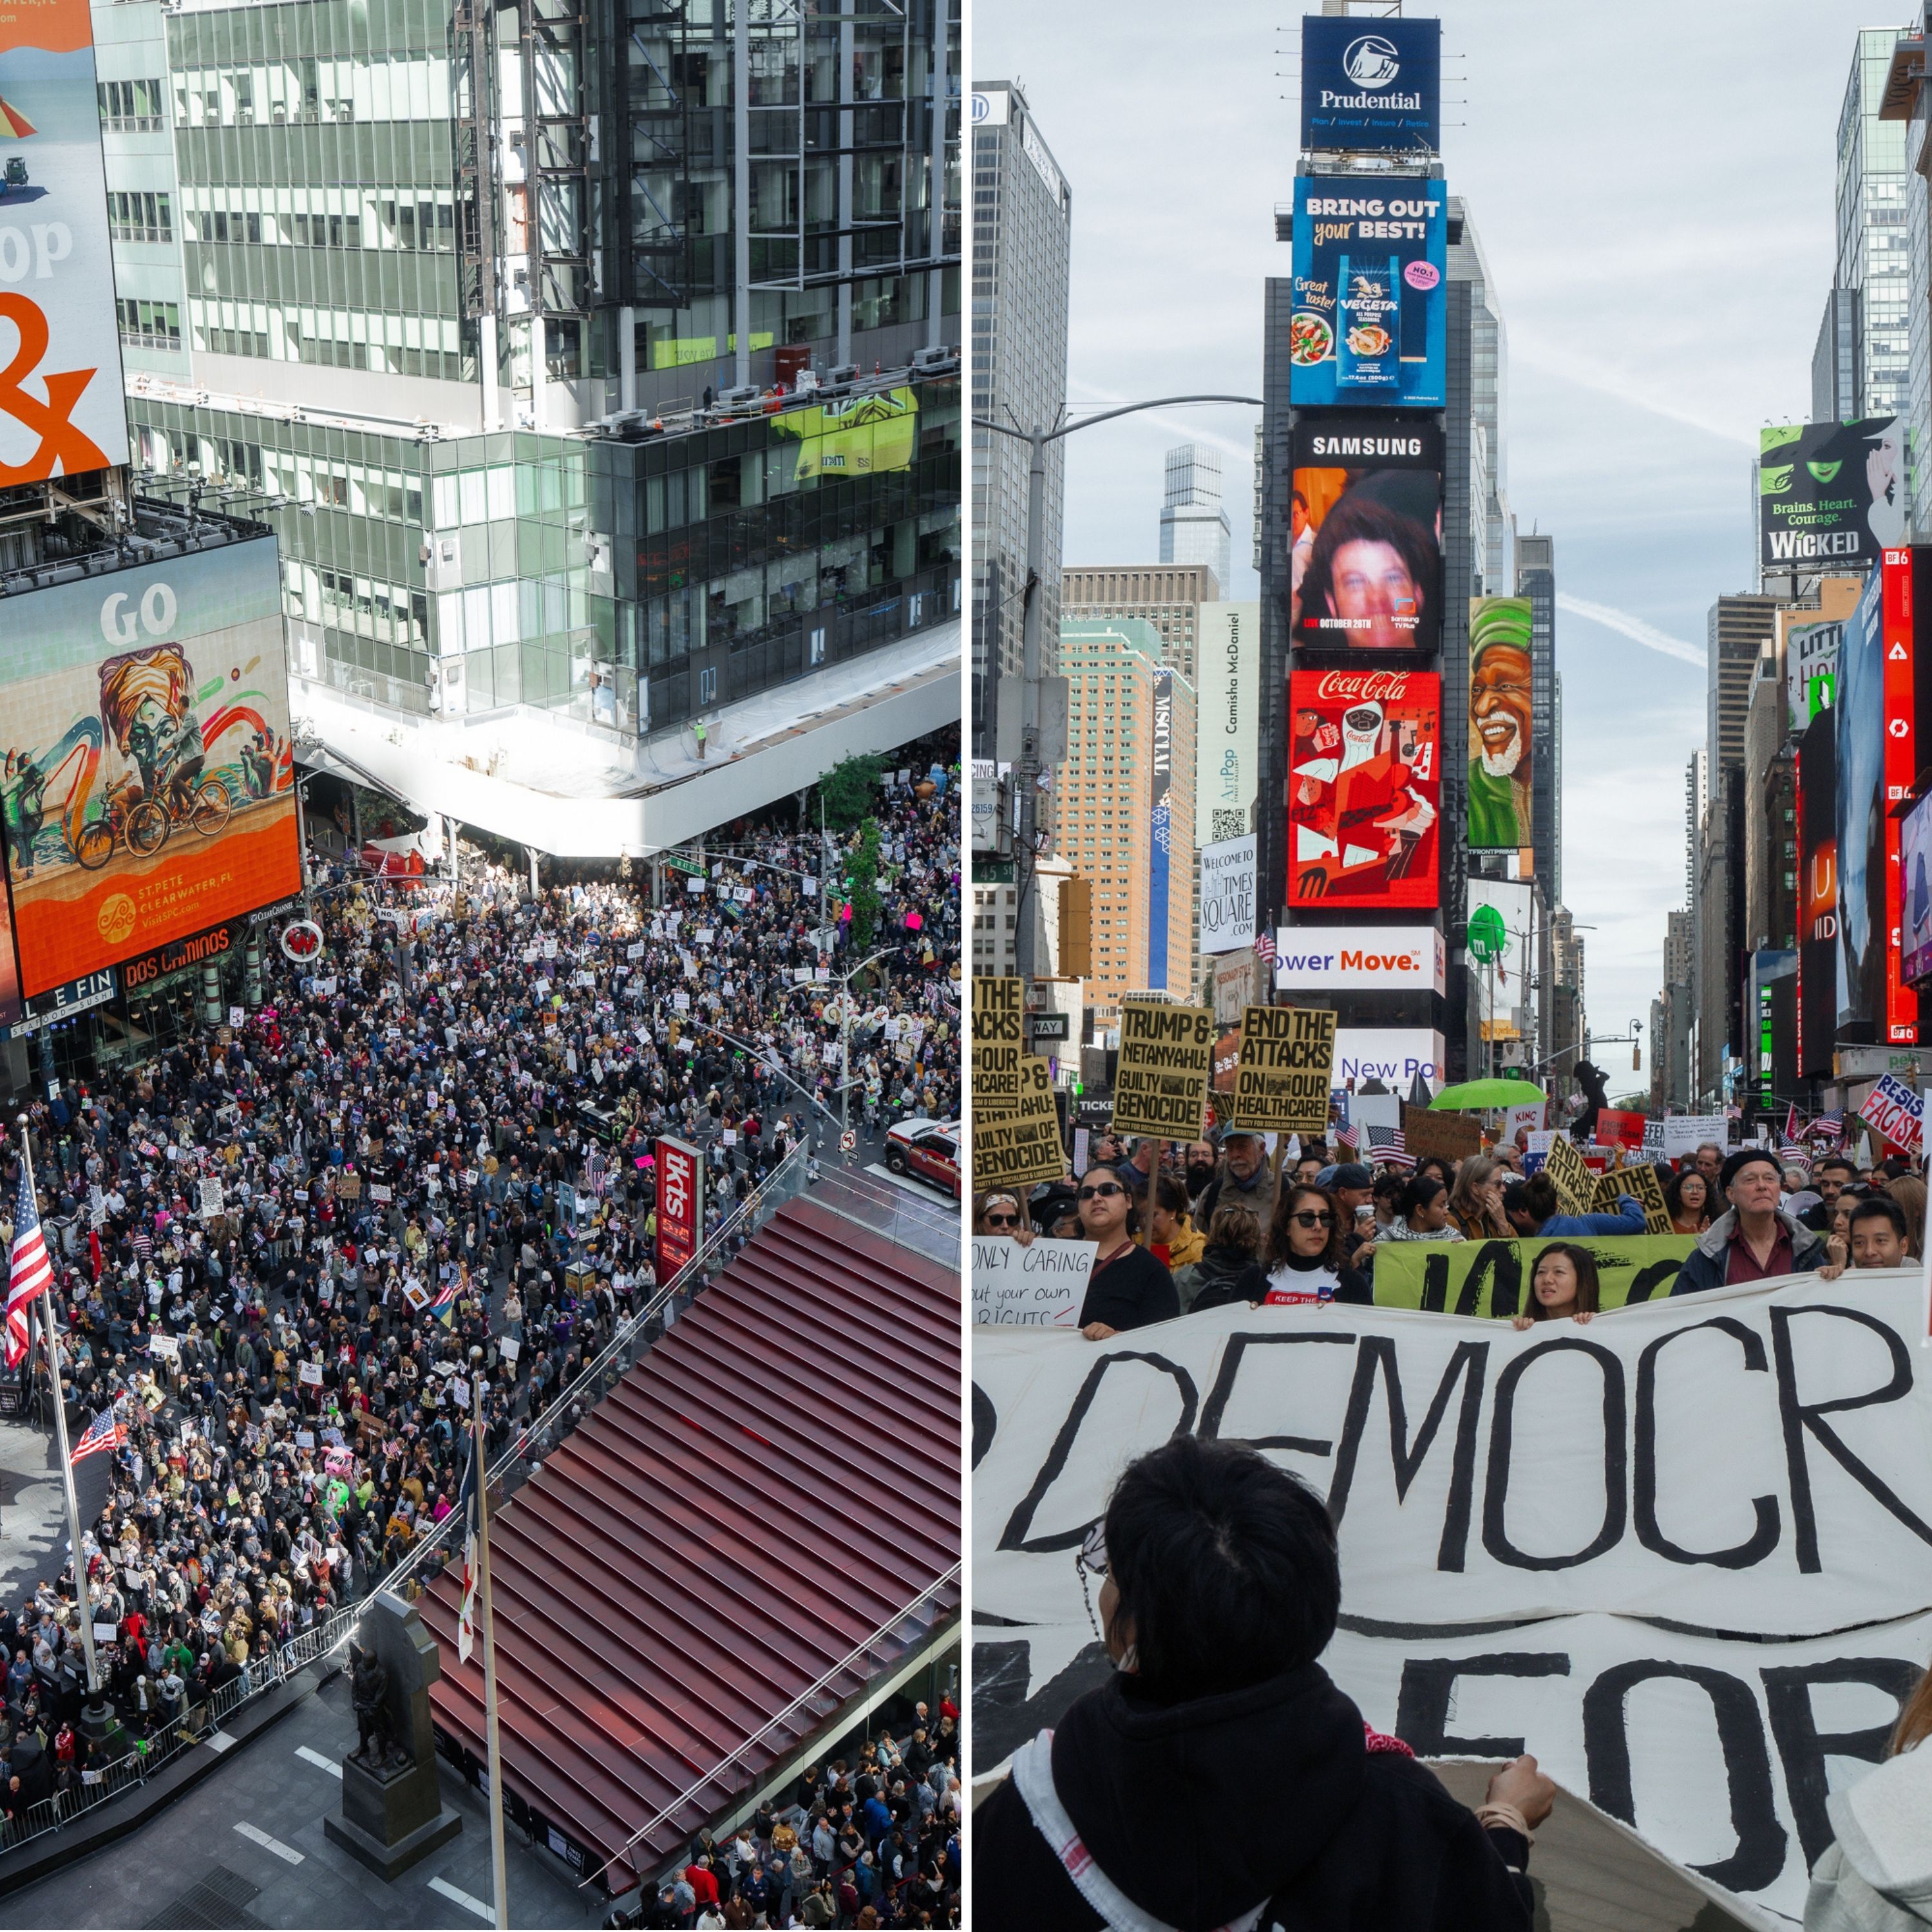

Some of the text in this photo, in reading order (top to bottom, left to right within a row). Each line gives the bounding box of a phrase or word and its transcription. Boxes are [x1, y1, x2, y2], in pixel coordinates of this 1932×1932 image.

[1320, 90, 1421, 110] Prudential
[1312, 117, 1329, 126] Plan
[1338, 118, 1362, 126] Invest
[1406, 120, 1430, 128] Retire
[1306, 198, 1441, 218] BRING OUT
[1314, 220, 1426, 247] your BEST!
[1412, 265, 1434, 278] NO.1
[1294, 276, 1329, 294] Great
[1305, 291, 1337, 310] taste!
[1340, 299, 1398, 311] VEGETA
[1312, 437, 1422, 456] SAMSUNG
[1772, 498, 1857, 515] Brains. Heart.
[1788, 513, 1842, 526] Courage.
[1900, 551, 1908, 565] 6
[100, 582, 177, 647] GO
[1303, 618, 1319, 628] LIVE
[1320, 618, 1352, 629] OCTOBER
[1390, 616, 1419, 625] Samsung
[1226, 612, 1239, 674] McDaniel
[1318, 670, 1412, 701] Coca-Cola
[1226, 677, 1238, 735] Camisha
[1220, 749, 1237, 802] ArtPop
[1203, 849, 1253, 871] WELCOME TO
[980, 865, 1014, 882] 45 St
[1224, 871, 1253, 896] TIMES
[138, 874, 184, 900] ST.PETE
[141, 901, 200, 929] VisitSPC.com
[1202, 892, 1253, 933] SQUARE
[289, 933, 316, 956] W
[126, 956, 158, 988] DOS
[1276, 954, 1334, 971] ower
[1340, 950, 1420, 971] Move.
[76, 969, 111, 999] FIN
[978, 979, 1020, 1010] THE
[12, 990, 113, 1036] SEAFOOD SUSHI
[1244, 1008, 1334, 1041] END THE
[1034, 1021, 1057, 1034] WAY
[1124, 1009, 1209, 1044] TRUMP &
[981, 1047, 1018, 1072] OUR
[1122, 1042, 1208, 1071] NETANYAHU:
[1240, 1039, 1331, 1070] ATTACKS
[1033, 1063, 1049, 1090] &
[1341, 1058, 1397, 1079] New
[1119, 1070, 1204, 1097] GUILTY OF
[1239, 1071, 1327, 1098] ON OUR
[1079, 1101, 1115, 1111] TICKE
[1116, 1092, 1202, 1126] GENOCIDE!
[1236, 1096, 1326, 1119] HEALTHCARE!
[1040, 1121, 1056, 1140] OF
[1143, 1123, 1165, 1133] SOCIALISM
[1171, 1127, 1198, 1138] LIBERATION
[1264, 1120, 1290, 1128] SOCIALISM
[1601, 1128, 1640, 1139] FASCISM
[1602, 1120, 1629, 1129] FIGHT
[974, 1140, 1059, 1177] GENOCIDE!
[1552, 1133, 1597, 1195] END THE
[665, 1152, 690, 1218] tkts
[975, 1178, 990, 1188] PARTY
[1002, 1172, 1030, 1184] SOCIALISM
[1034, 1168, 1061, 1178] LIBERATION
[1547, 1155, 1591, 1213] ATTACKS
[1618, 1164, 1656, 1193] THE
[1644, 1214, 1672, 1235] UR
[1023, 1247, 1088, 1273] CARING
[996, 1288, 1030, 1309] your
[1035, 1287, 1071, 1300] own
[1274, 1296, 1317, 1305] KEEP THE
[994, 1303, 1932, 1575] DEMOCR
